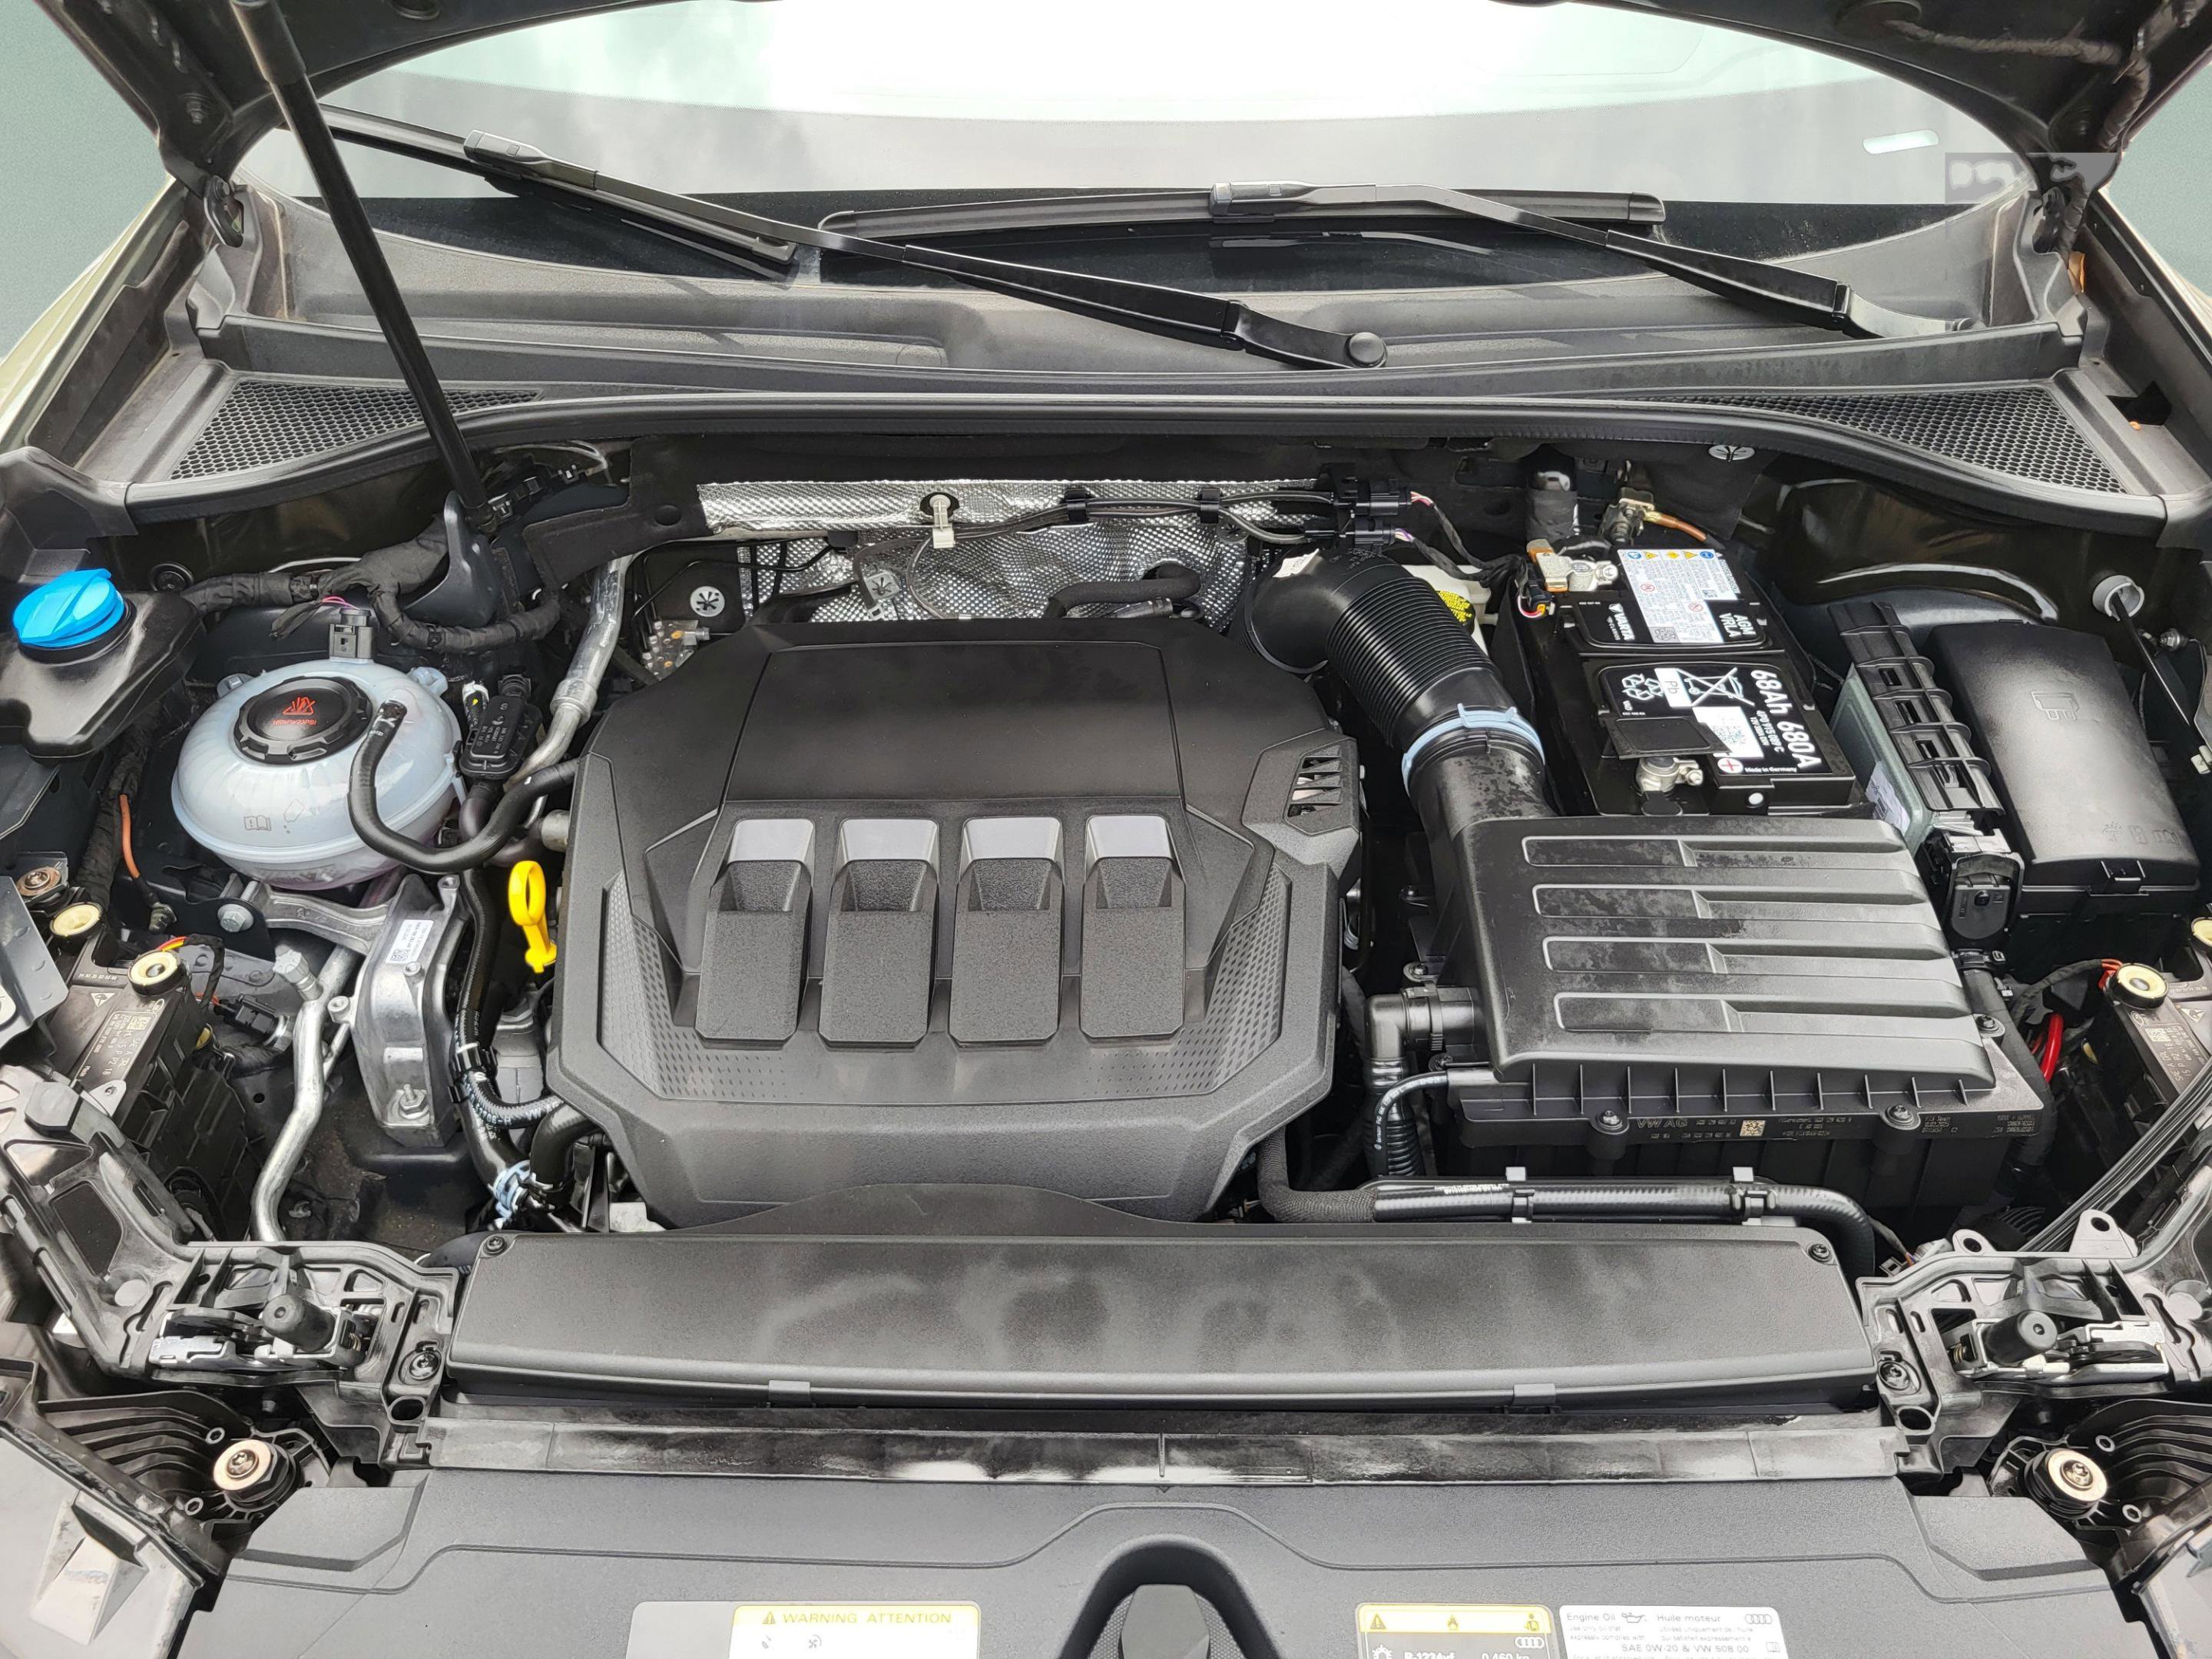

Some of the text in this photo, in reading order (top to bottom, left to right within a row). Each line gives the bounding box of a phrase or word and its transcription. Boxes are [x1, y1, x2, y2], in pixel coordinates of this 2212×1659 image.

[1614, 612, 1635, 641] VARTA
[1719, 612, 1742, 637] VRLA
[1734, 614, 1757, 635] AGM
[1664, 680, 1680, 694] Pb
[1750, 669, 1822, 769] 68Ah 680A
[1636, 1118, 1662, 1128] VW
[1663, 1118, 1689, 1128] AG
[783, 1612, 953, 1624] WARNING ATTENTION
[1566, 1613, 1600, 1623] Engine
[1602, 1612, 1616, 1621] Oil
[1657, 1614, 1681, 1622] Huile
[1621, 1644, 1642, 1652] SAE
[1682, 1644, 1690, 1653] &
[1694, 1644, 1712, 1653] VW
[1715, 1644, 1734, 1653] 508
